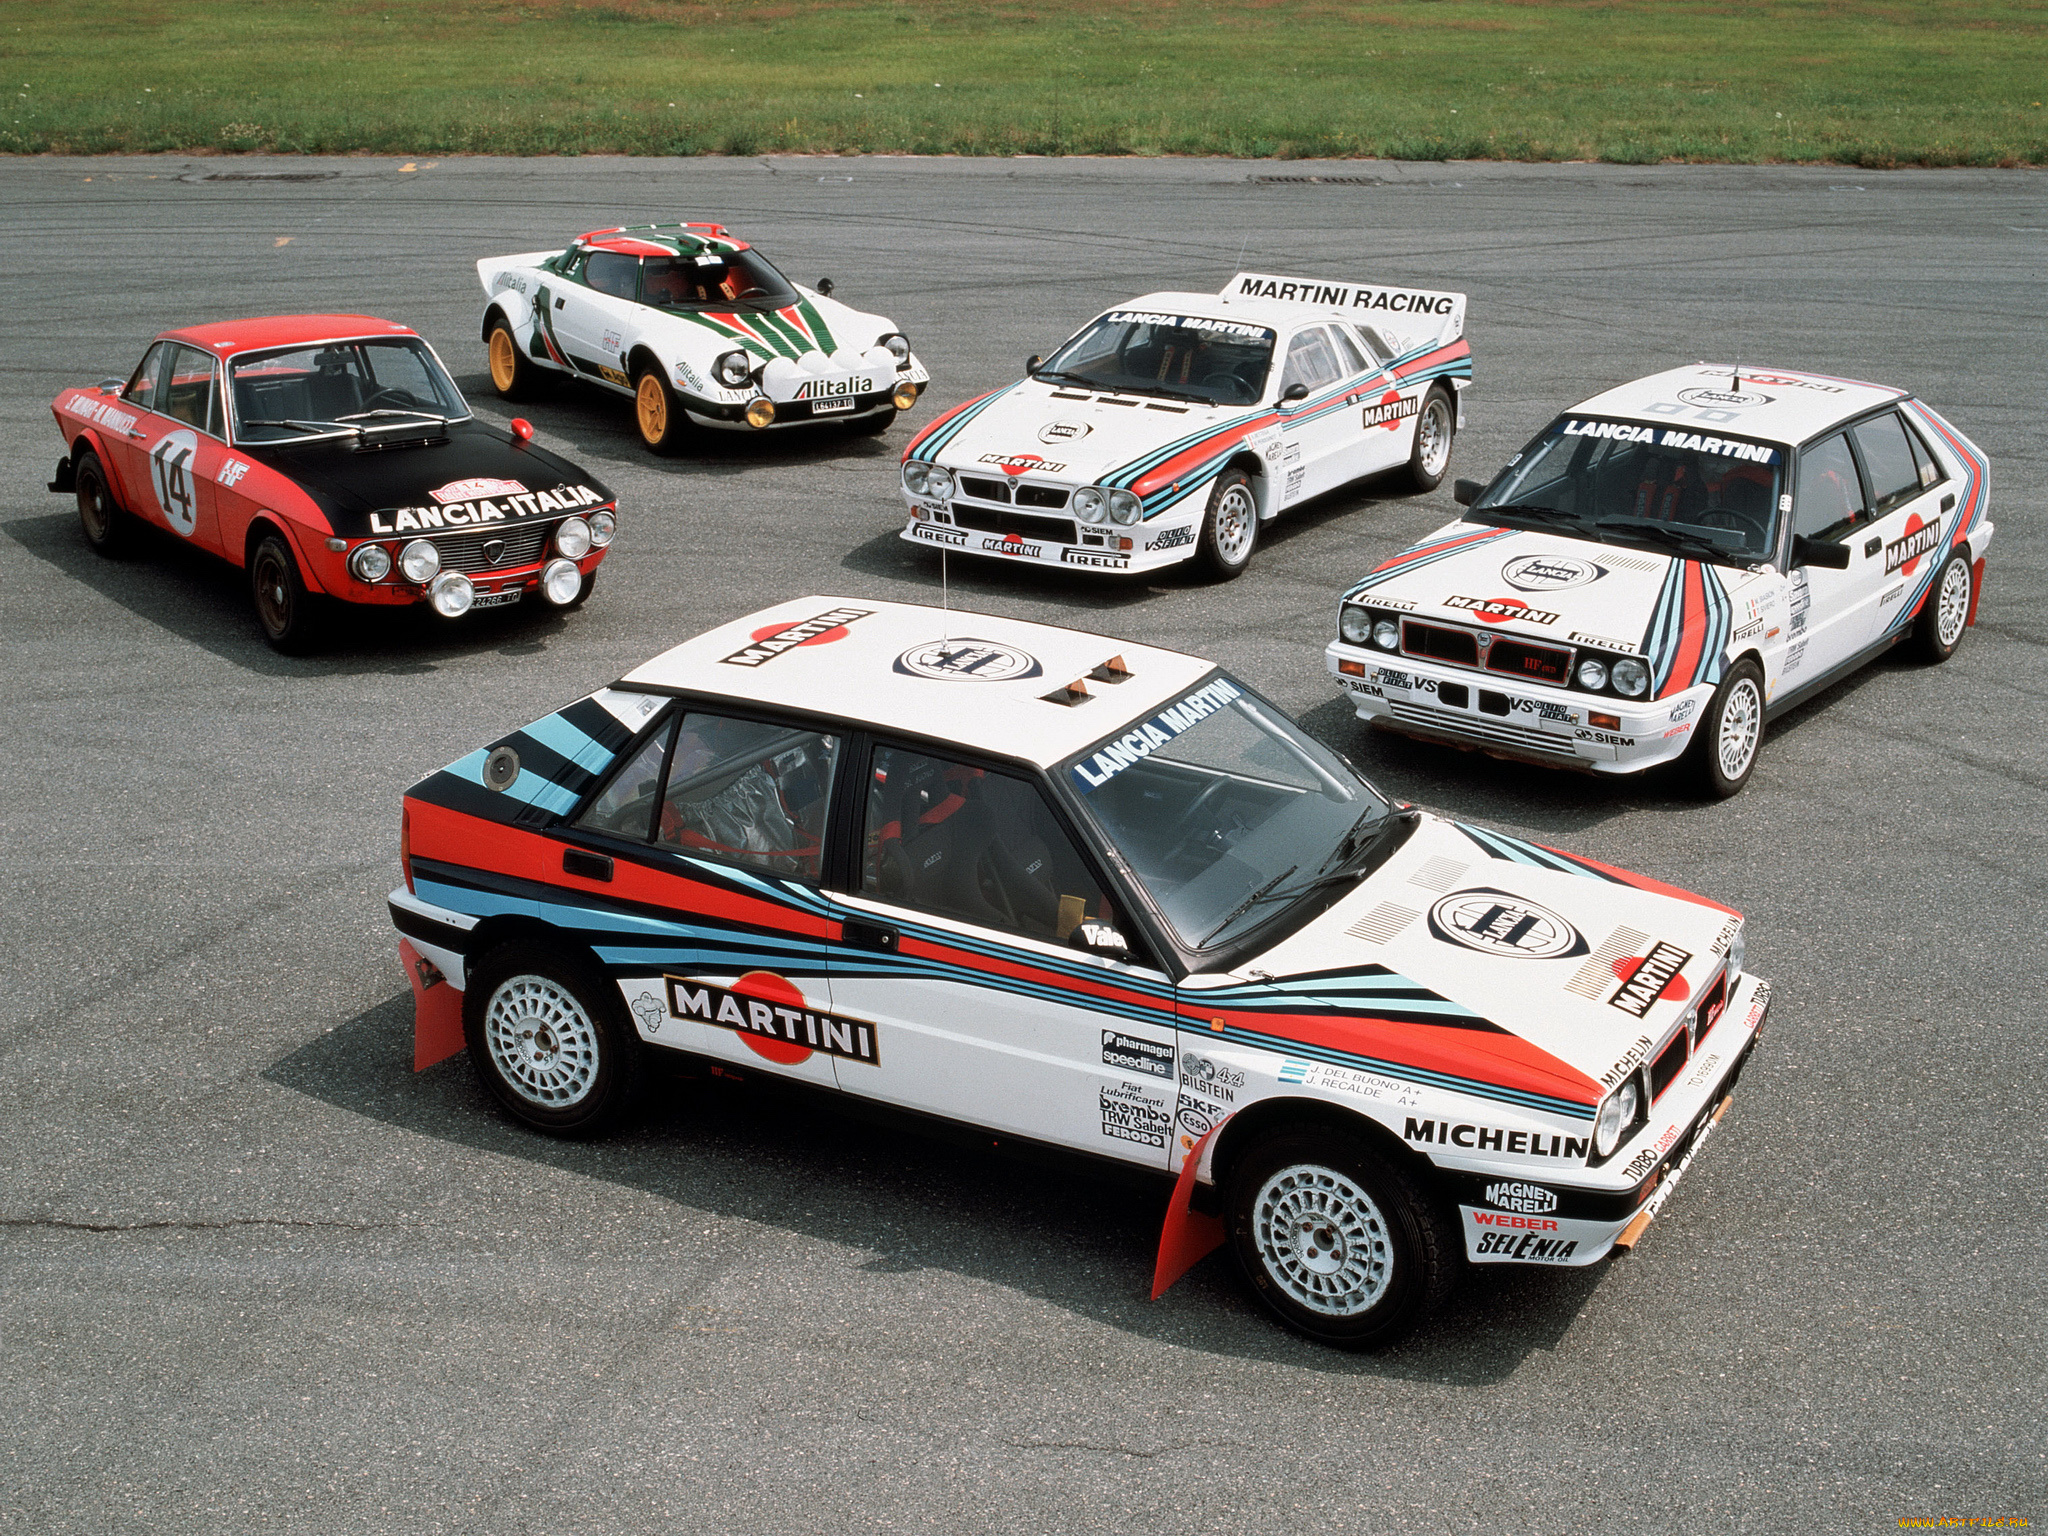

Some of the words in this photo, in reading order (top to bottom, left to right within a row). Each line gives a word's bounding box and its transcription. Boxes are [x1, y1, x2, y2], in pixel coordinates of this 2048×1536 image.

[497, 271, 527, 294] Alitalia
[1239, 278, 1348, 307] MARTINI
[1352, 290, 1453, 315] RACING
[1108, 313, 1176, 327] LANCIA
[1181, 316, 1266, 337] MARTINI
[675, 361, 704, 392] Alitalia
[792, 376, 873, 399] Alitalia
[1702, 370, 1842, 393] MARTINI
[1364, 399, 1416, 426] MARTINI
[1051, 426, 1076, 436] LANCIA
[1564, 420, 1654, 443] LANCIA
[1661, 431, 1773, 463] MARTINI
[218, 458, 250, 487] HF
[981, 454, 1063, 472] MARTINI
[154, 440, 193, 523] 14
[370, 485, 604, 533] LANCIA-ITALIA
[912, 522, 968, 546] PIRELLI
[1092, 527, 1113, 535] SIEM
[1159, 526, 1191, 539] OLIO
[984, 540, 1040, 557] MARTINI
[1145, 541, 1162, 551] VS
[1163, 536, 1196, 548] FIAT
[1886, 522, 1938, 571] MARTINI
[1061, 547, 1131, 569] PIRELLI
[1529, 565, 1575, 580] LANCIA
[1358, 594, 1418, 611] PIRELLI
[1447, 596, 1558, 624] MARTINI
[733, 608, 870, 667] MARTINI
[1733, 617, 1764, 643] PIRELLI
[1568, 632, 1636, 653] PIRELLI
[1379, 669, 1407, 680] OLIO
[1524, 657, 1541, 671] HF
[1351, 682, 1384, 697] SIEM
[1383, 678, 1411, 690] FIAT
[1414, 676, 1438, 692] VS
[1510, 697, 1534, 713] VS
[1535, 701, 1567, 713] OLIO
[1540, 711, 1571, 722] FIAT
[1074, 723, 1172, 787] LANCIA
[1158, 678, 1241, 734] MARTINI
[1595, 733, 1635, 746] SIEM
[1664, 723, 1690, 738] WEBER
[1482, 909, 1528, 938] LANCIA
[1710, 916, 1741, 958] MICHELIN
[1613, 944, 1688, 1015] MARTINI
[674, 984, 871, 1058] MARTINI
[1116, 1035, 1173, 1058] pharmagel
[1103, 1050, 1166, 1075] speedline
[1600, 1035, 1653, 1089] MICHELIN
[1121, 1081, 1143, 1093] Fiat
[1182, 1073, 1234, 1102] BILSTEIN
[1216, 1066, 1245, 1088] 4x4
[1306, 1076, 1316, 1085] J.
[1321, 1078, 1383, 1098] RECALDE
[1310, 1066, 1320, 1074] J.
[1324, 1069, 1349, 1080] DEL
[1352, 1074, 1400, 1091] BUONO
[1100, 1086, 1165, 1108] Lubrificanti
[1100, 1094, 1171, 1123] brembo
[1179, 1094, 1221, 1115] SKF
[1101, 1109, 1131, 1126] TRW
[1133, 1117, 1174, 1137] Sabelt
[1104, 1124, 1162, 1145] FERODO
[1404, 1117, 1590, 1158] MICHELIN
[1622, 1149, 1658, 1183] TURBO
[1653, 1125, 1682, 1153] GARRETT
[1485, 1182, 1558, 1203] MAGNETI
[1485, 1194, 1558, 1213] MARELLI
[1473, 1211, 1558, 1231] WEBER
